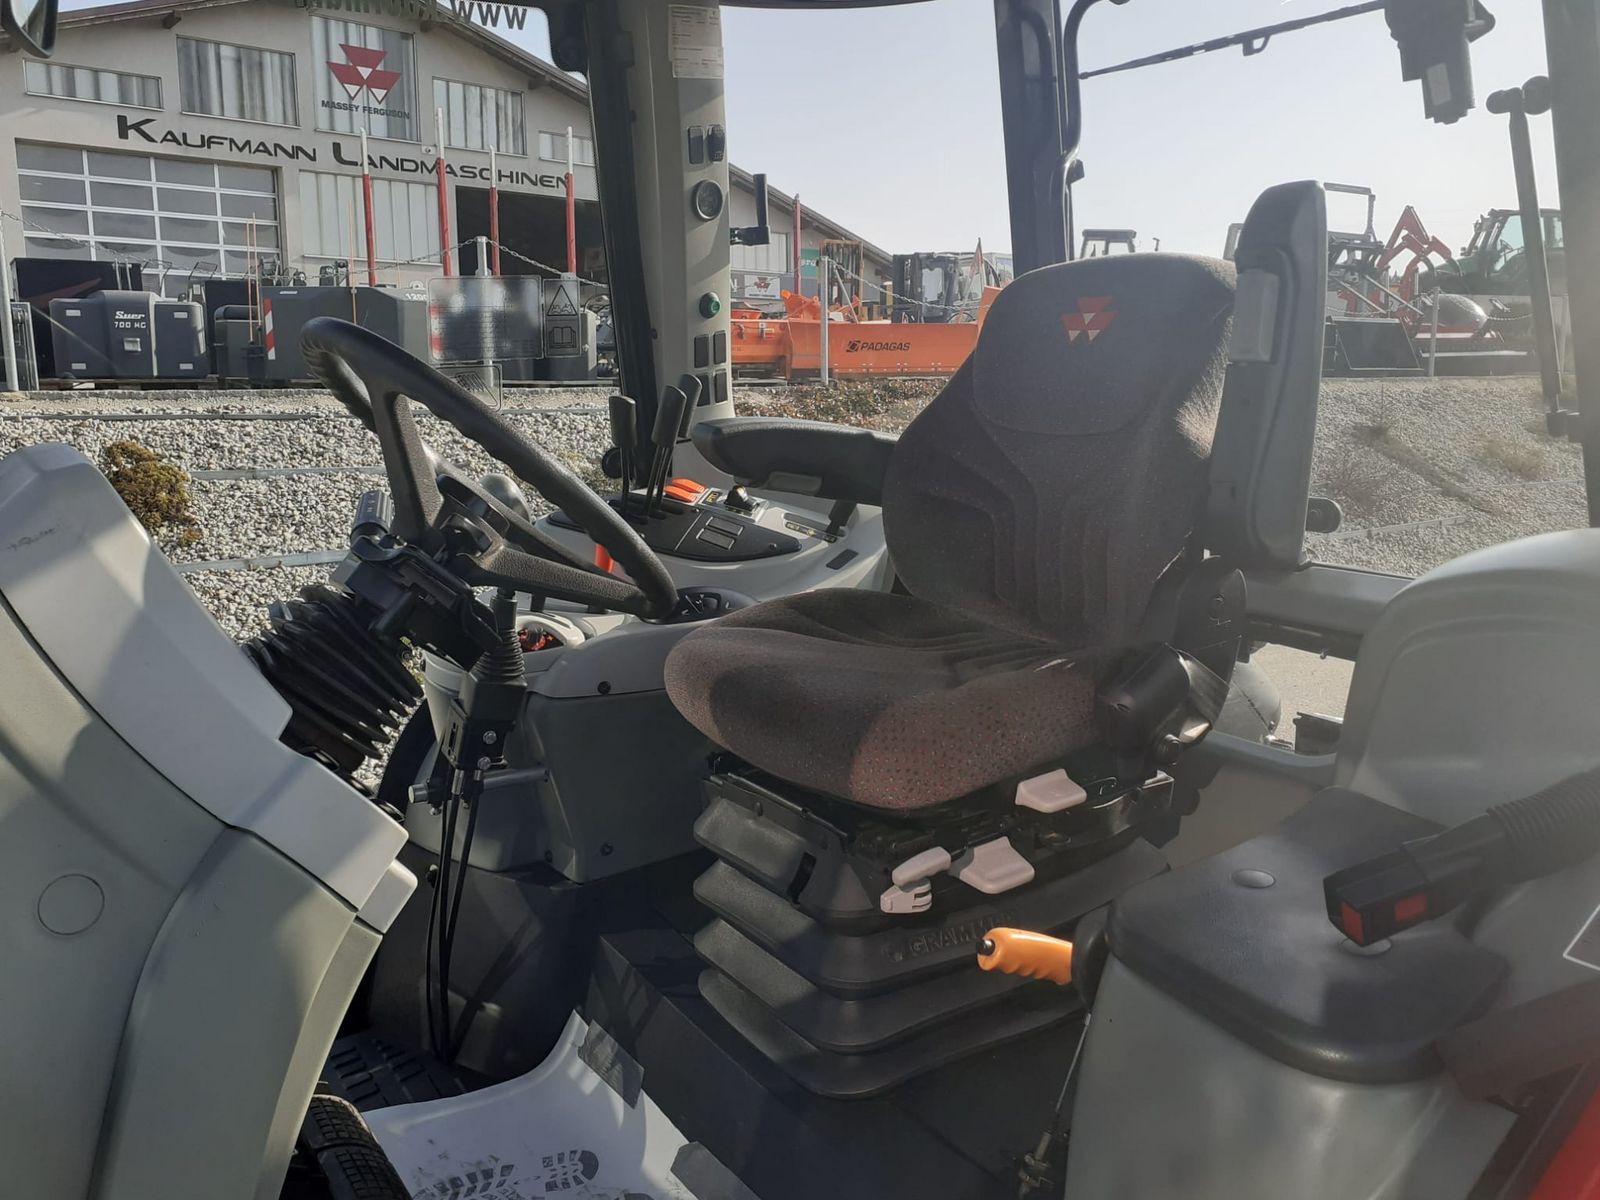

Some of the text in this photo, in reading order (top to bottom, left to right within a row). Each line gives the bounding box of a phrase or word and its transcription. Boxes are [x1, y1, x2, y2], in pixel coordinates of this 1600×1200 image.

[321, 100, 410, 119] MASSEY FERGUSON
[117, 115, 316, 161] KAUFMANN
[115, 310, 146, 320] Suer
[114, 321, 131, 329] 700
[861, 342, 911, 351] PADAGAS
